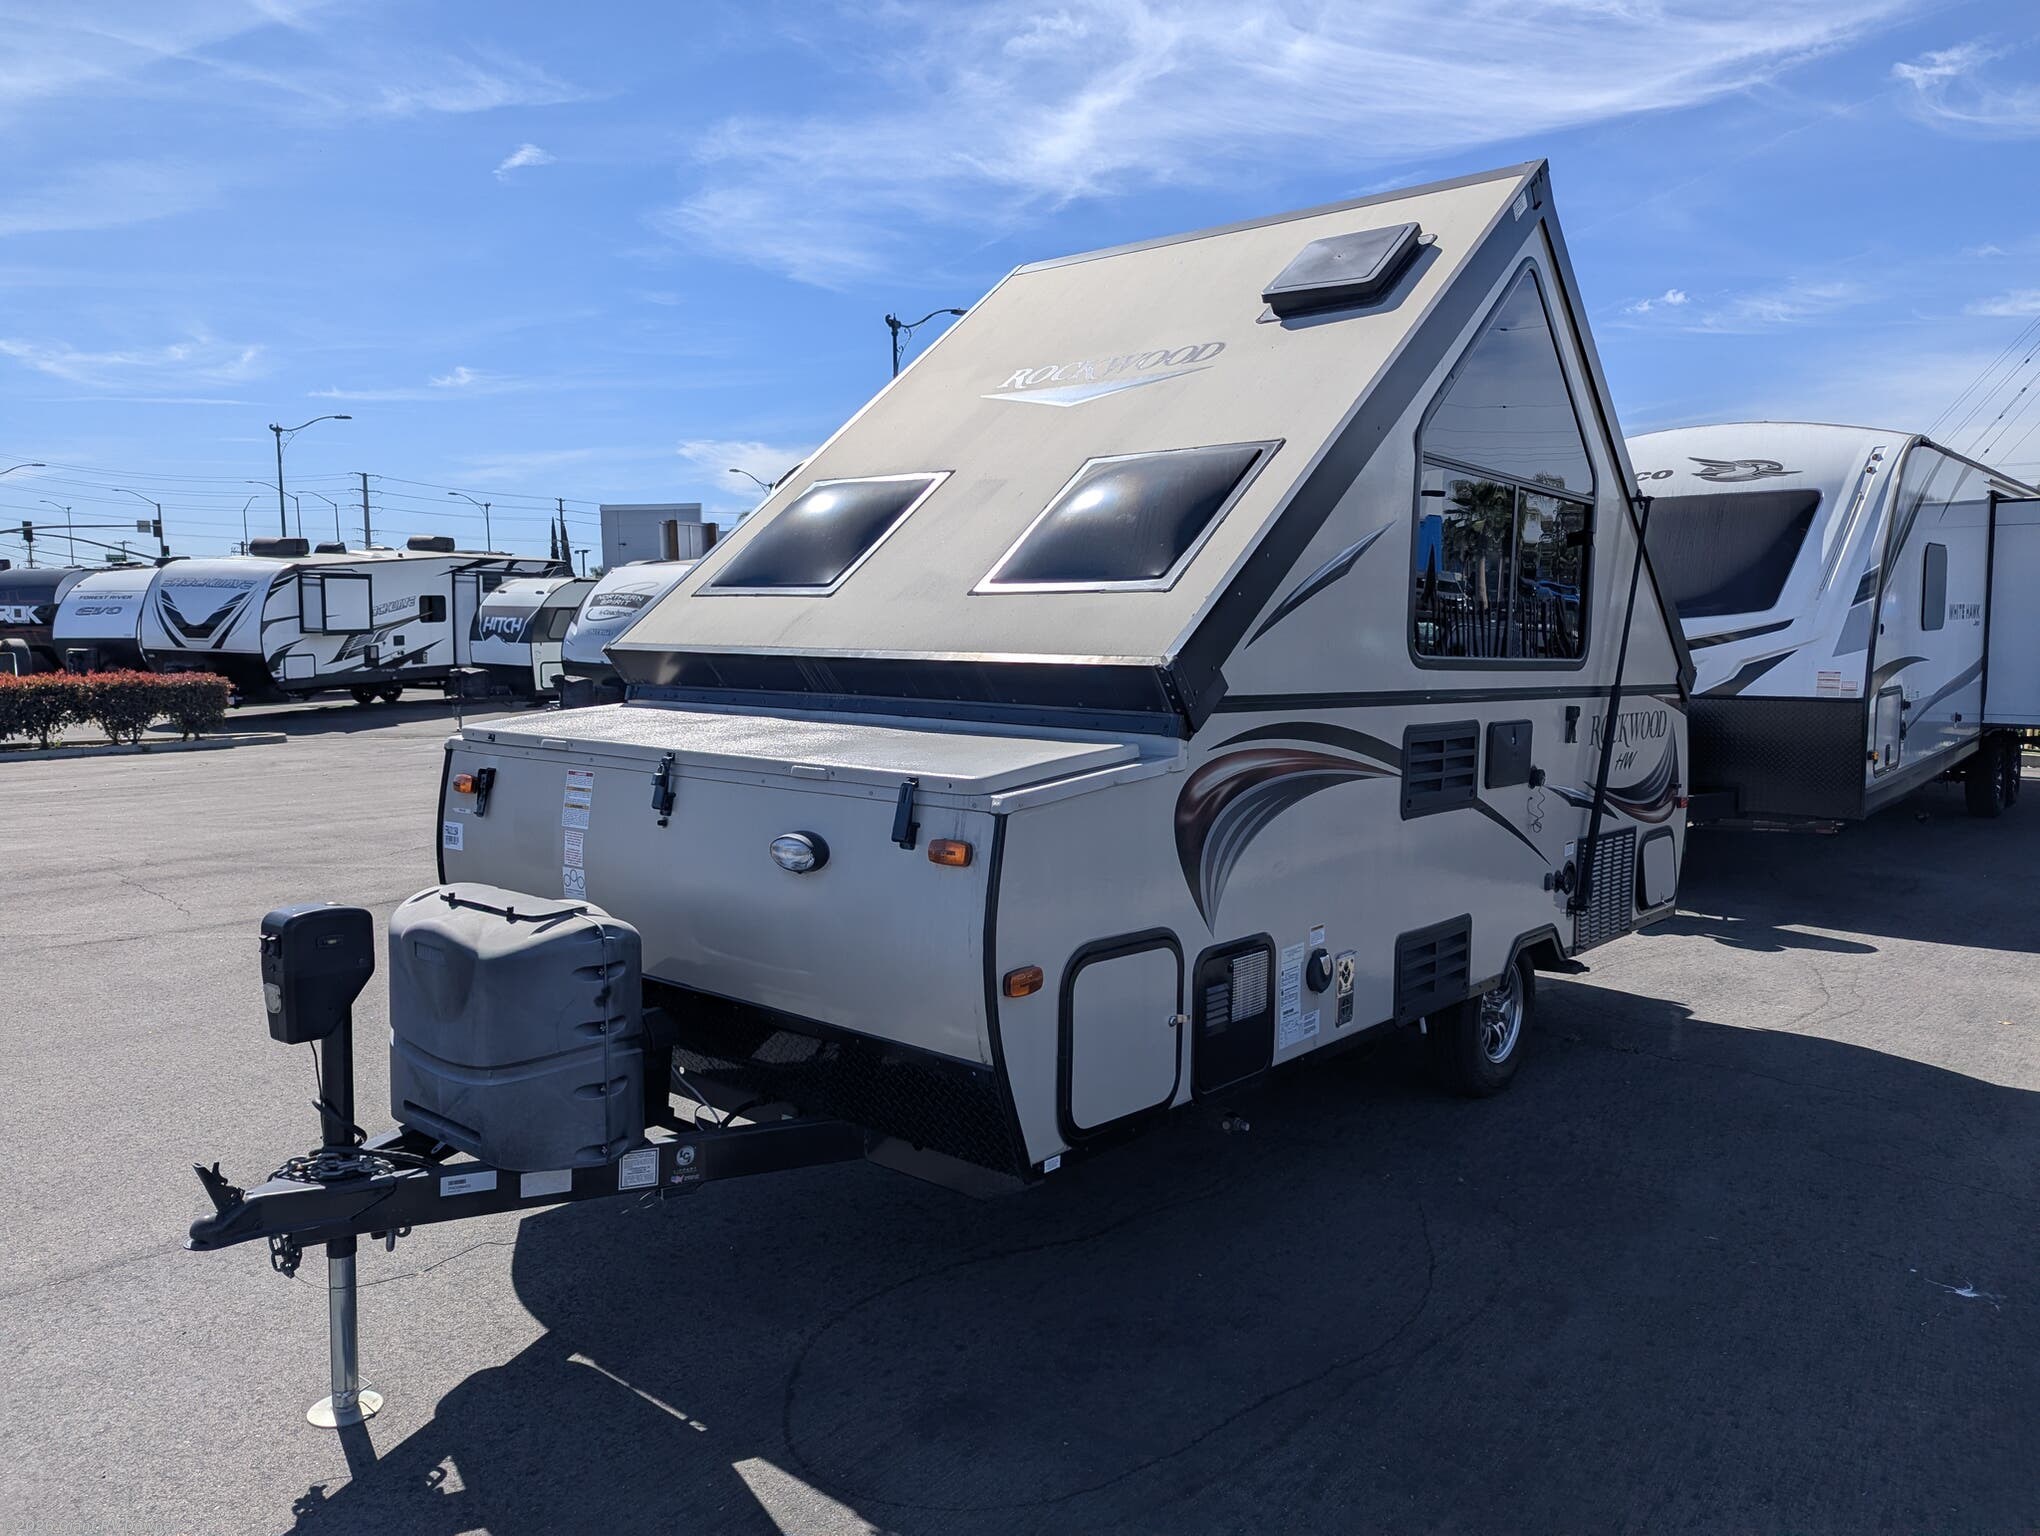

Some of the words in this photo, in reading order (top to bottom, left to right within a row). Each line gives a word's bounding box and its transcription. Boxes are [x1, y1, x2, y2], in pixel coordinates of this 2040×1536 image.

[997, 342, 1226, 389] ROCKWOOD
[598, 594, 644, 602] NORTHERN
[75, 606, 122, 616] EVO
[482, 616, 524, 634] HITCH
[1614, 751, 1638, 771] HW
